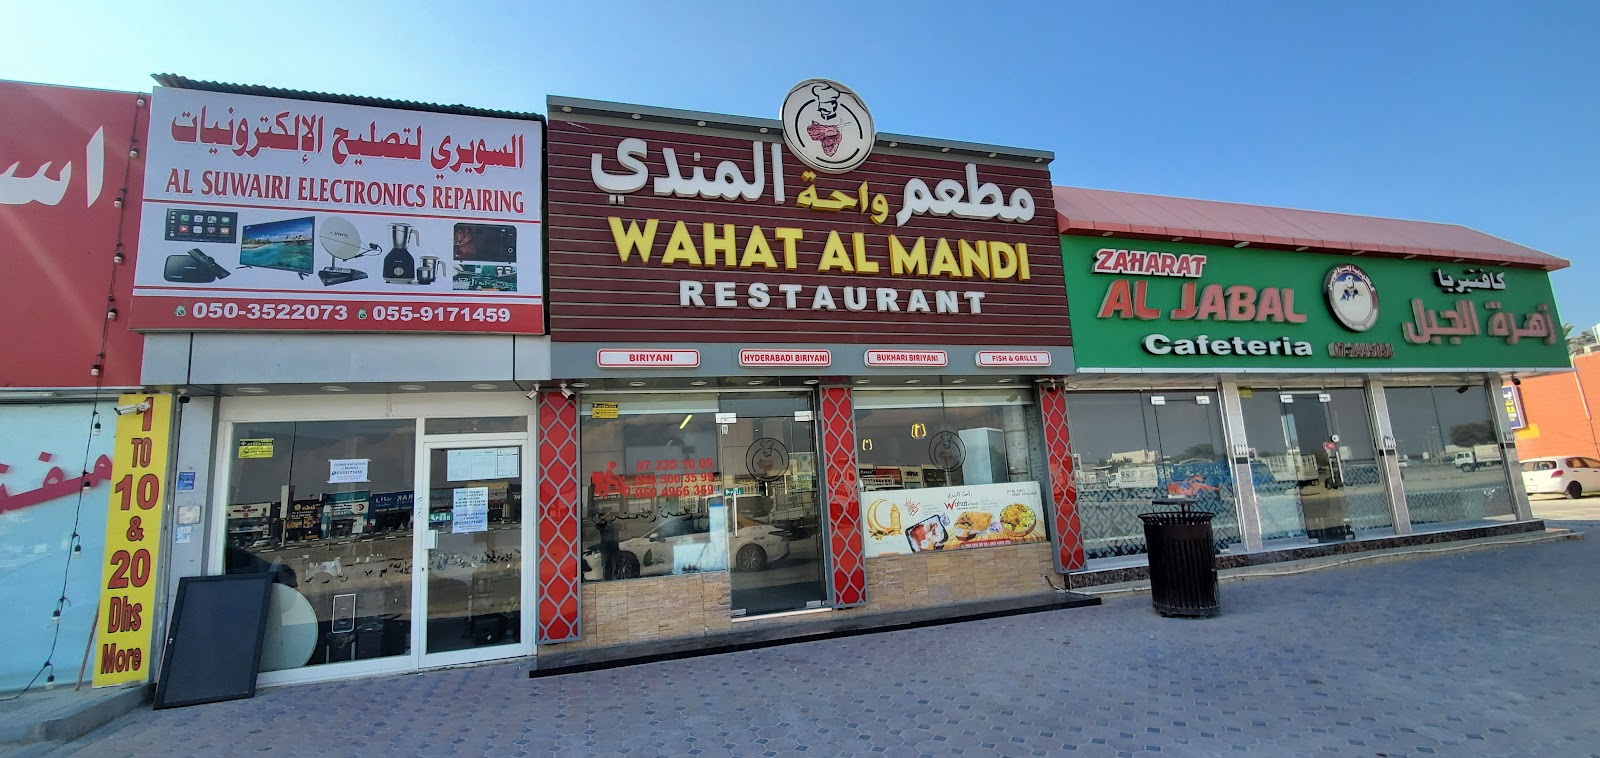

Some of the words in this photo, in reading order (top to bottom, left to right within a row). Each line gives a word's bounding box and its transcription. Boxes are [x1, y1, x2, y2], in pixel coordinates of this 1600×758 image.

[171, 104, 324, 165] الإلكترونيات
[331, 120, 422, 166] لتصليح
[430, 133, 524, 181] السويري
[591, 138, 785, 205] المندي
[166, 168, 193, 194] AL
[201, 170, 291, 200] SUWAIRI
[298, 177, 426, 208] ELECTRONICS
[432, 186, 524, 215] REPAIRING
[796, 171, 889, 226] واحة
[897, 163, 1035, 227] مطعم
[607, 216, 803, 272] WAHAT
[817, 229, 880, 274] AL
[888, 234, 1031, 282] MANDI
[1094, 248, 1207, 278] ZAHARAT
[679, 280, 985, 315] RESTAURANT
[1436, 267, 1506, 294] كافتيريا
[192, 302, 348, 321] 050-3522073
[372, 305, 511, 323] 055-9171459
[1097, 279, 1161, 321] AL
[1170, 282, 1307, 324] JABAL
[1402, 298, 1481, 345] الجبل
[1485, 301, 1557, 346] زهرة
[628, 353, 673, 362] BIRIYANI
[744, 353, 794, 362] HYDERABADI
[795, 353, 828, 362] BIRIYANI
[876, 353, 908, 363] BUKHARI
[909, 354, 939, 363] BIRIYANI
[1014, 355, 1038, 363] GRILLS
[1144, 333, 1313, 357] Cafeteria
[136, 396, 154, 432] 1
[131, 437, 153, 468] TO
[636, 460, 651, 471] 07
[655, 459, 677, 471] 235
[682, 458, 695, 469] 10
[699, 457, 713, 469] 05
[115, 473, 160, 511] 10
[660, 473, 680, 485] 500
[684, 472, 698, 483] 35
[660, 485, 689, 498] 4966
[693, 484, 714, 497] 359
[126, 515, 144, 542] &
[107, 548, 151, 590] 20
[107, 596, 143, 634] Dhs
[100, 643, 142, 674] More
